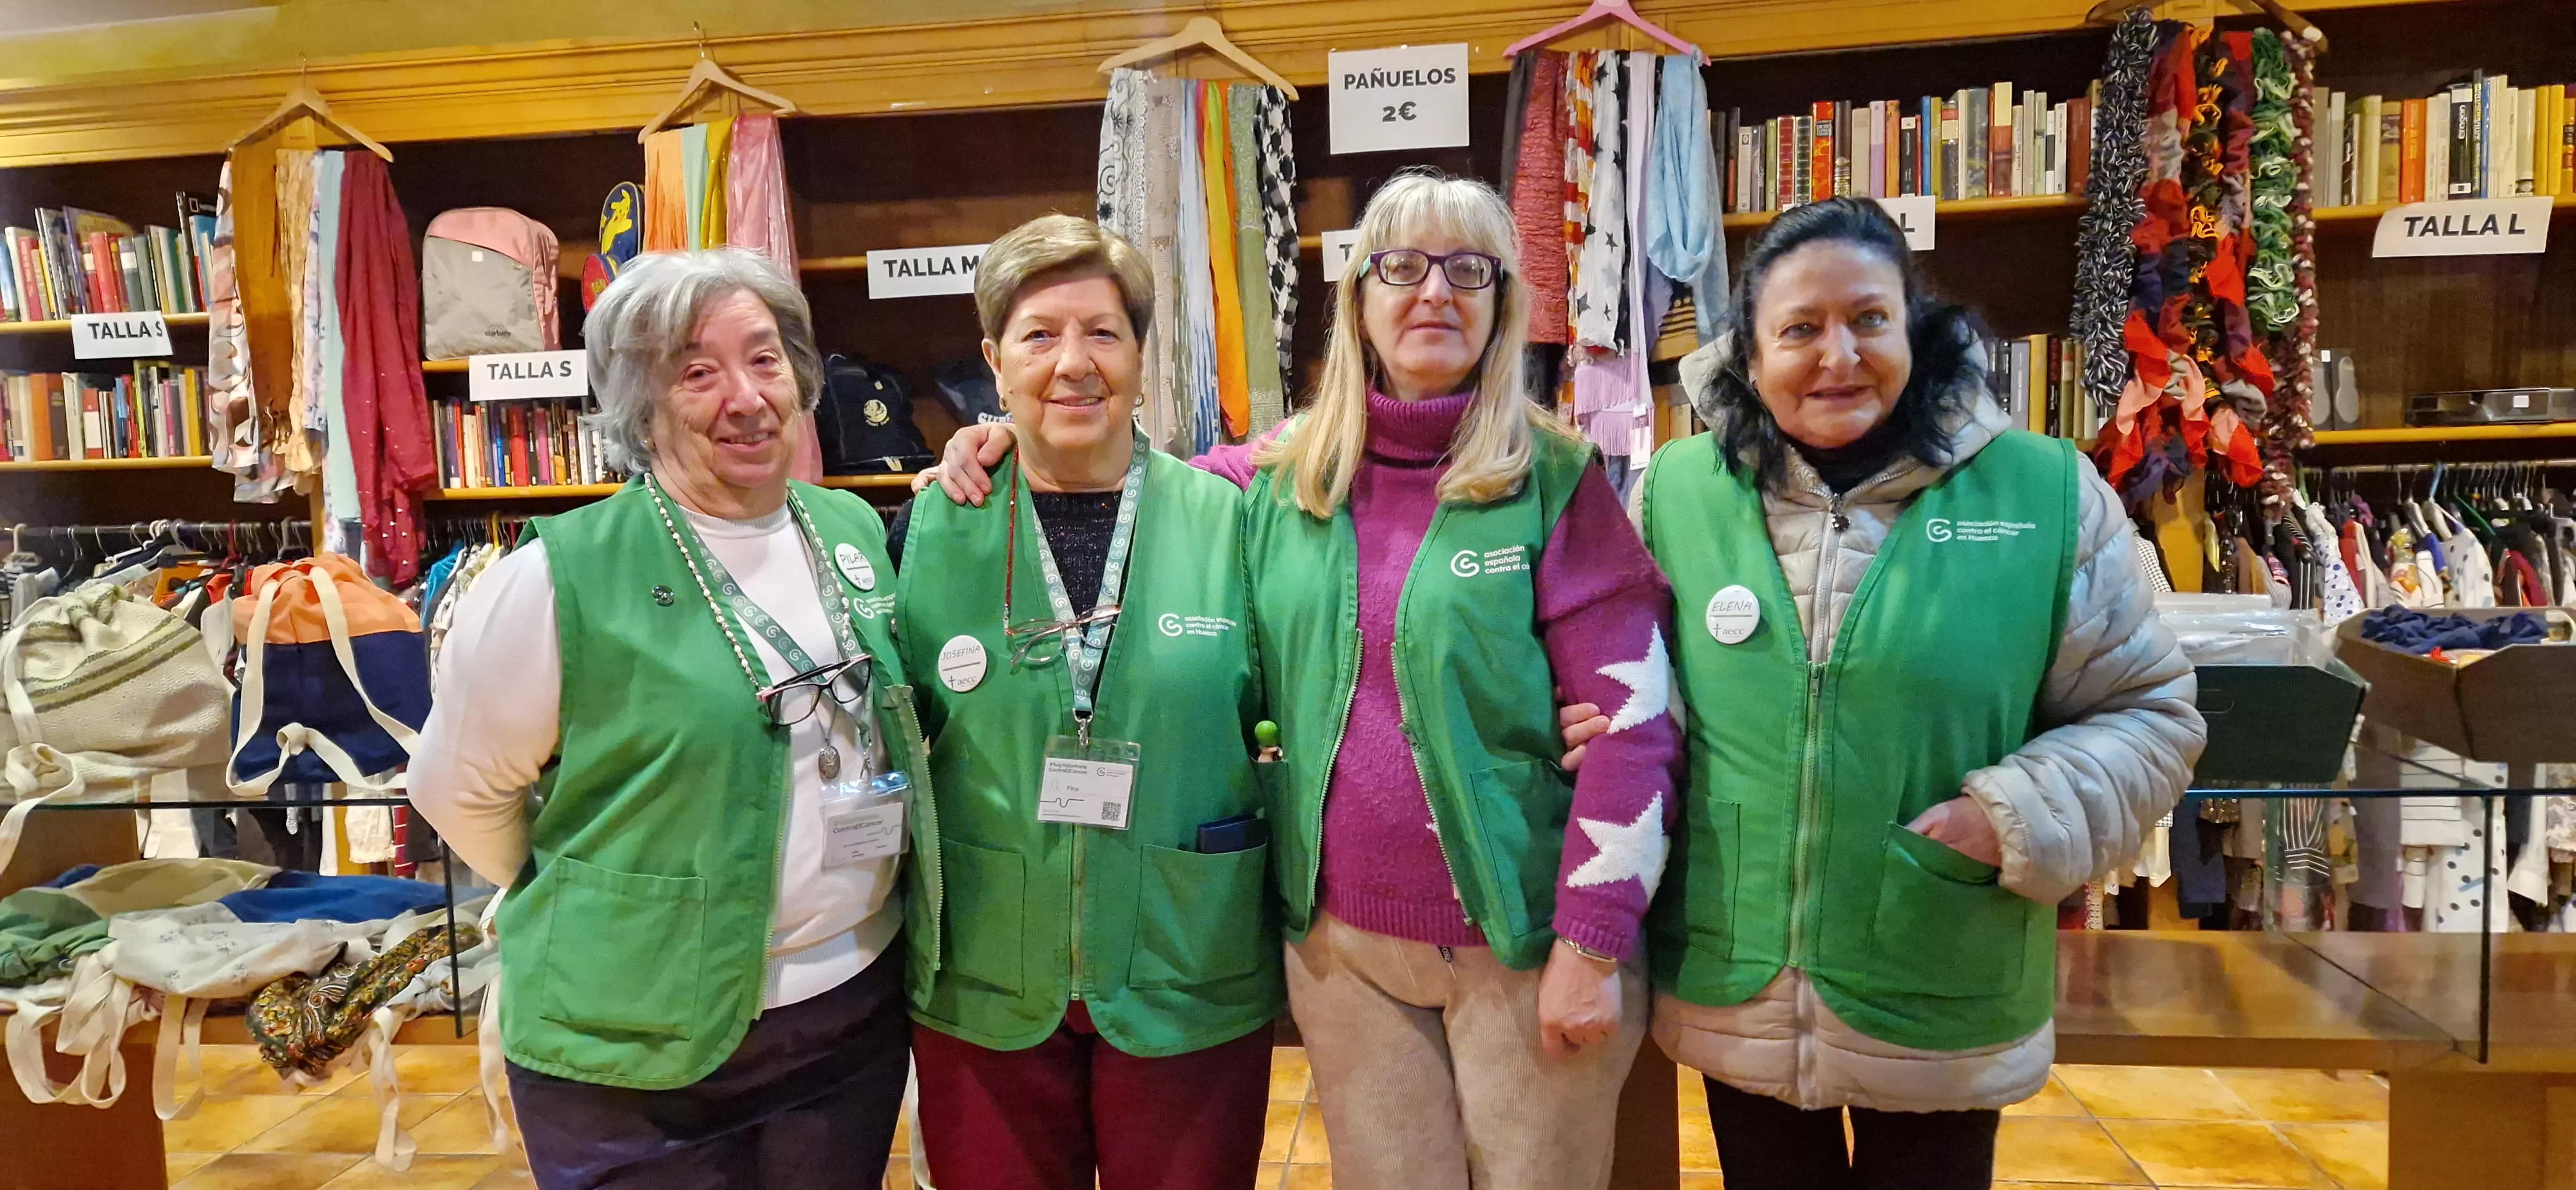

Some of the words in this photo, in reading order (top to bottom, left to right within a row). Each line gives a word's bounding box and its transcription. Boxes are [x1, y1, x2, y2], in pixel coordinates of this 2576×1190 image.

[1344, 68, 1456, 90] PAÑUELOS
[1382, 101, 1417, 122] 2€
[2404, 214, 2499, 237] TALLA
[2508, 213, 2526, 234] L
[883, 256, 956, 278] TALLA
[961, 255, 980, 274] M
[88, 321, 152, 339] TALLA
[155, 321, 163, 337] S
[487, 361, 553, 380] TALLA
[560, 360, 572, 377] S
[1484, 545, 1525, 558] asociación
[1484, 554, 1520, 567] española
[1485, 565, 1511, 574] contra
[1712, 600, 1752, 612] ELENA
[940, 645, 981, 661] JOSEFINA
[957, 676, 978, 685] aecc
